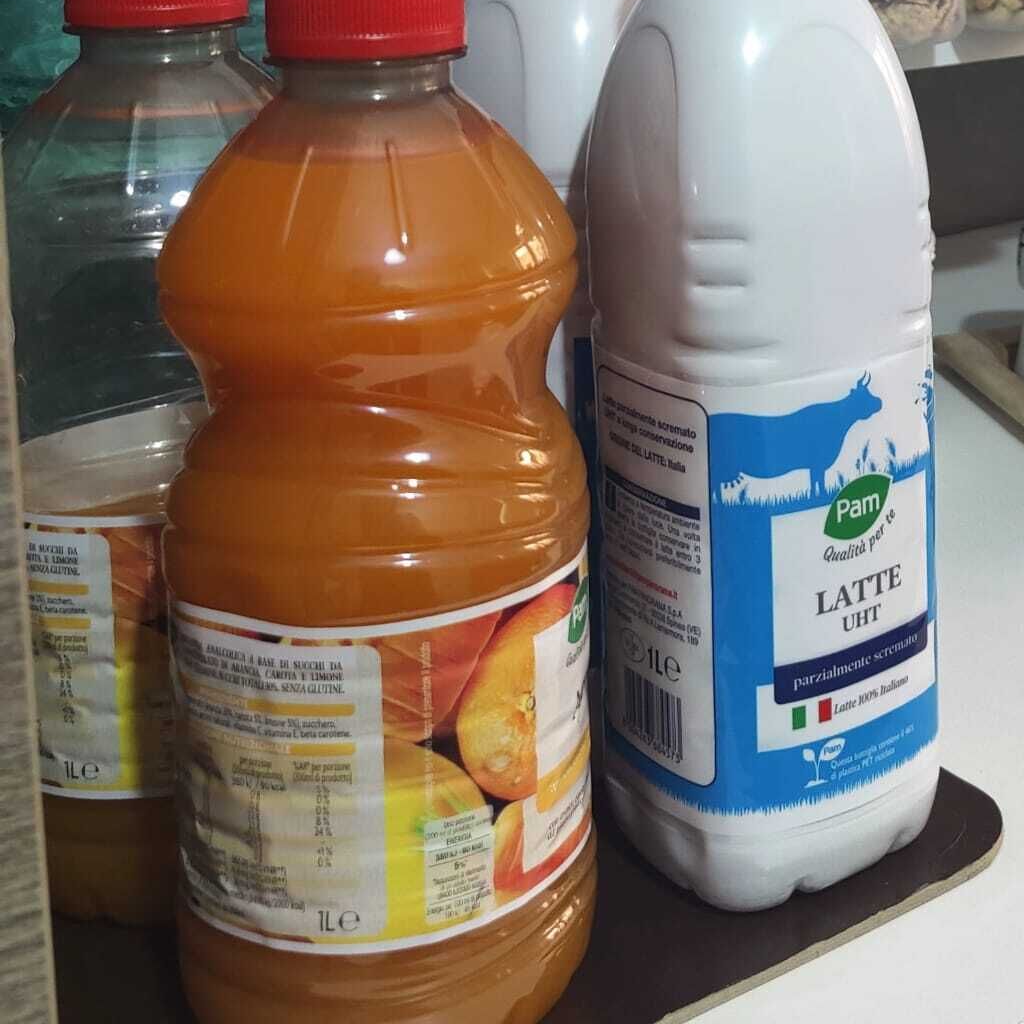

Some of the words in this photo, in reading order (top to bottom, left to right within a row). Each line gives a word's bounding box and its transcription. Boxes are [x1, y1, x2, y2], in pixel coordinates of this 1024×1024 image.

[657, 420, 697, 439] scremato
[836, 492, 880, 523] Pam
[823, 540, 866, 563] Qualità
[869, 522, 884, 552] per
[886, 509, 896, 524] te
[52, 555, 80, 565] LIMONE
[815, 563, 902, 616] LATTE
[842, 603, 882, 632] UHT
[206, 643, 246, 664] ANALCOLICA
[257, 655, 276, 668] BASE
[280, 659, 289, 669] DI
[293, 660, 325, 671] SUCCHI
[329, 661, 343, 671] DA
[793, 655, 871, 691] parzialmente
[873, 633, 919, 661] scremato
[264, 668, 297, 681] CAROTA
[311, 671, 345, 681] LIMONE
[281, 682, 305, 694] SENZA
[307, 683, 345, 695] GLUTINE.
[833, 696, 857, 715] Latte
[858, 690, 879, 706] 100%
[879, 675, 909, 696] Italiano
[823, 742, 842, 756] Pam
[318, 910, 335, 932] 1L
